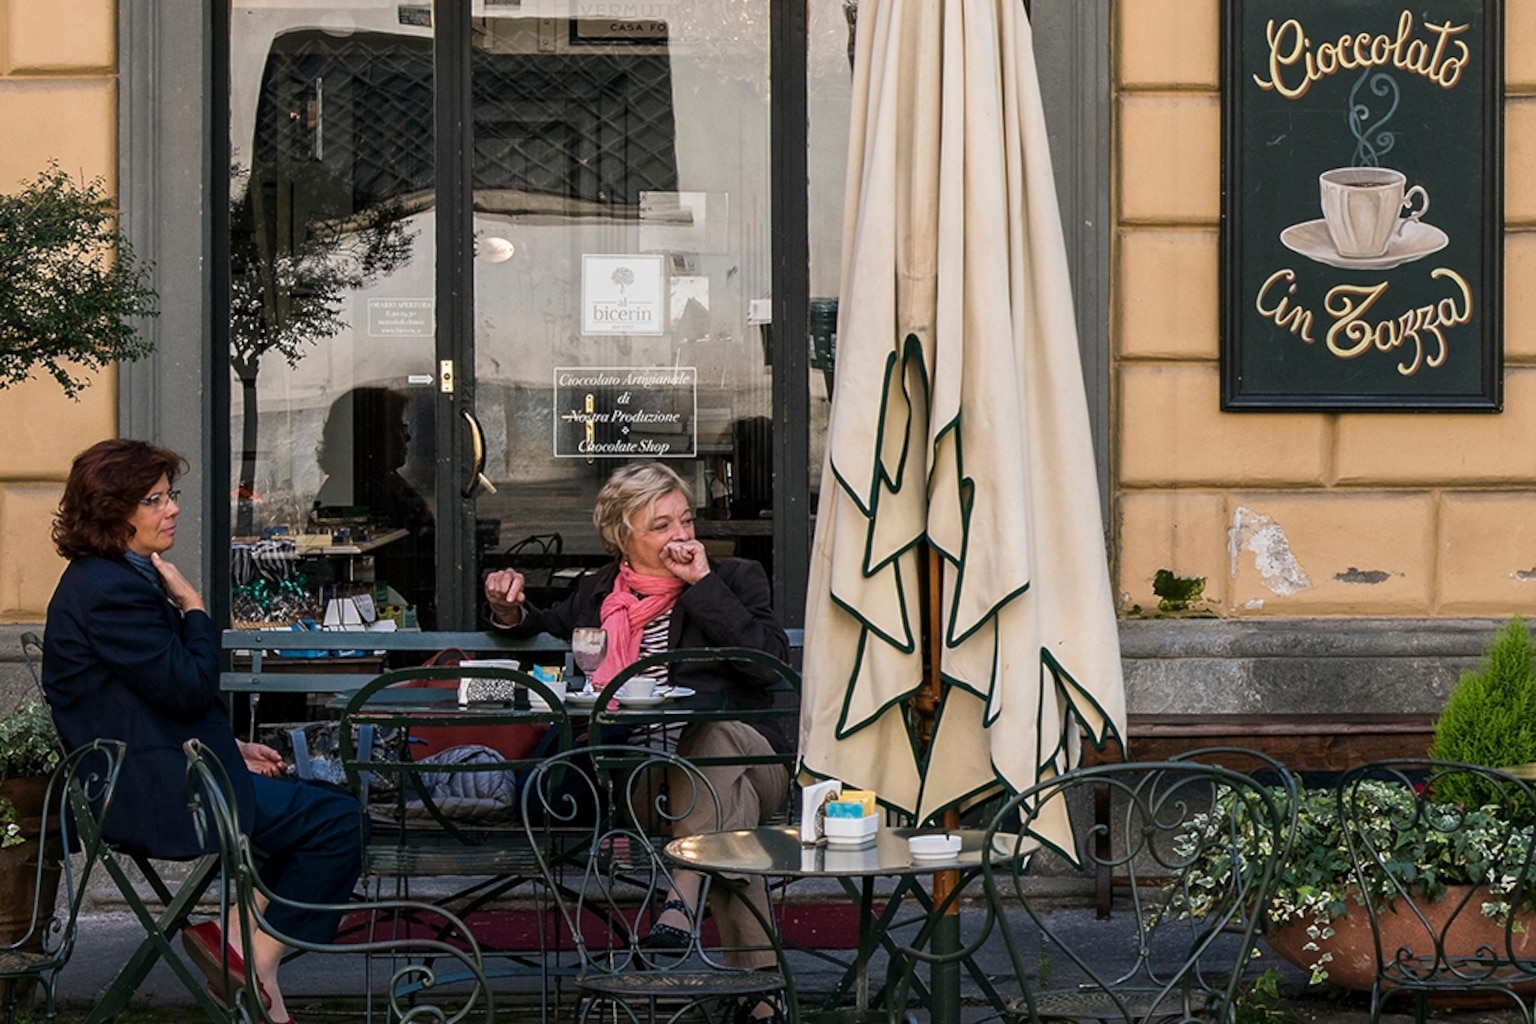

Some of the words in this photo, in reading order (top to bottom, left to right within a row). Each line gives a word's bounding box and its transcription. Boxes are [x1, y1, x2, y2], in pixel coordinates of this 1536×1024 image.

[609, 23, 644, 32] CASA
[650, 23, 667, 32] FO
[1252, 9, 1472, 100] Cioccolato
[617, 297, 628, 307] al
[593, 304, 652, 321] bicerin
[1323, 267, 1474, 376] Tazza
[558, 372, 620, 387] Cioccolato
[621, 372, 691, 388] Artigianale
[616, 391, 632, 405] di
[567, 409, 610, 424] Nostra
[611, 409, 680, 424] Produzione
[640, 439, 670, 457] Shop
